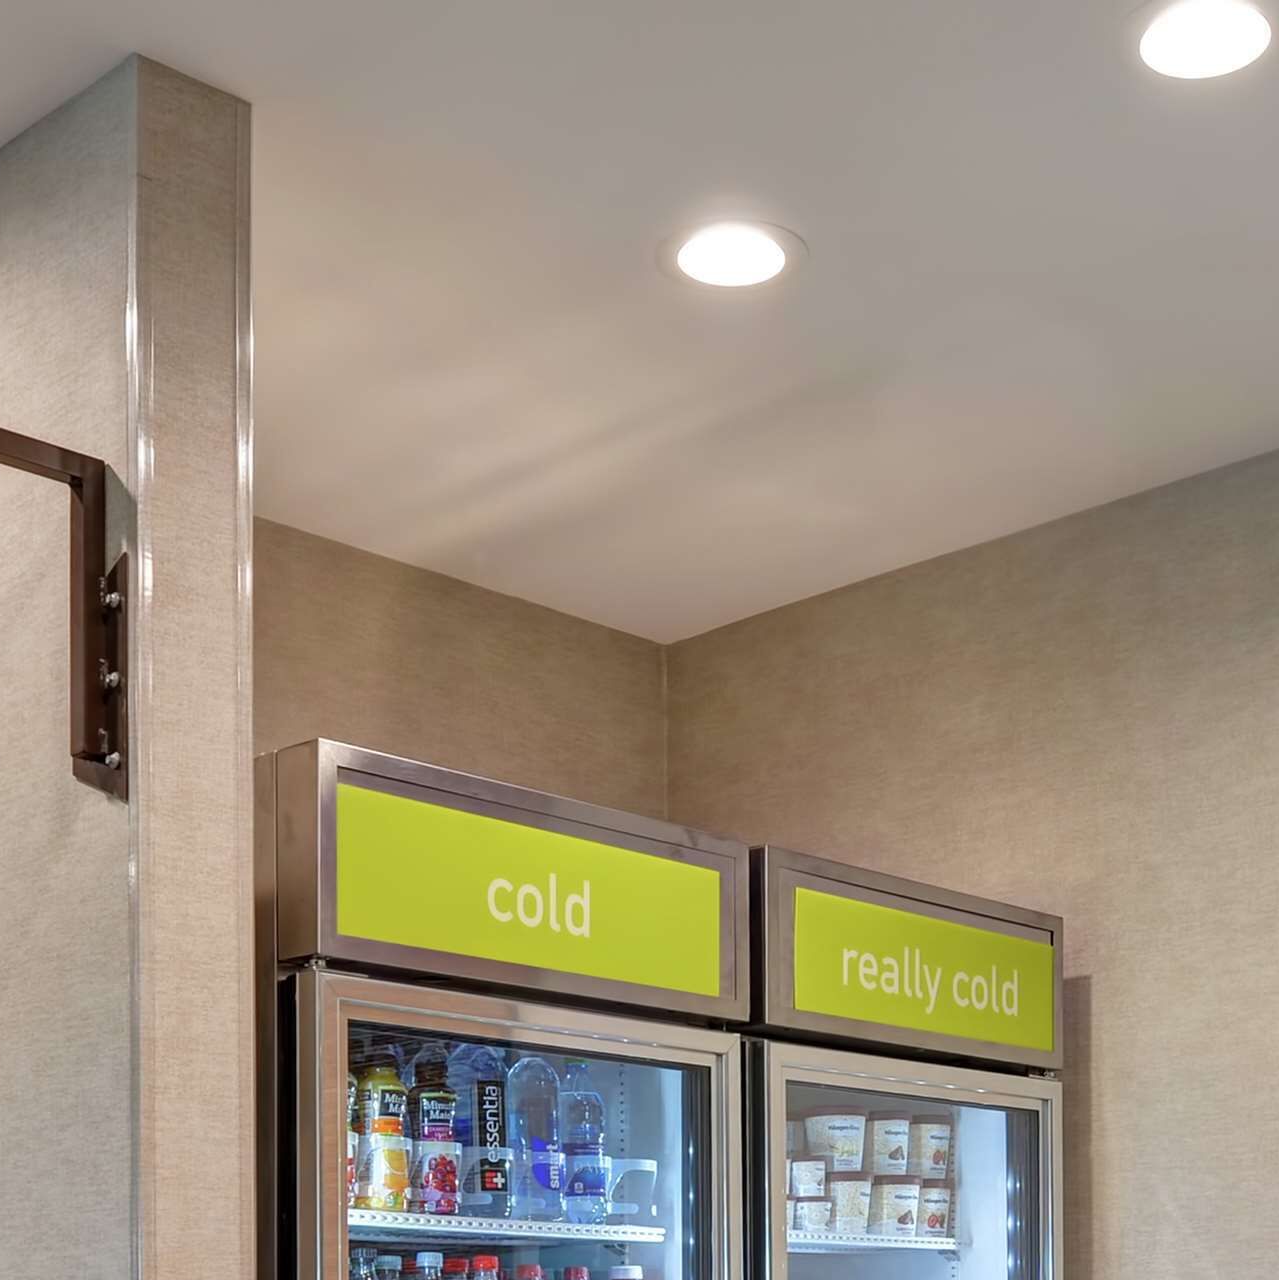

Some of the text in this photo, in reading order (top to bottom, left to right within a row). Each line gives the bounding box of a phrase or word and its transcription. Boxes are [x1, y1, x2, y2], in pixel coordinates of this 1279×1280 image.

[488, 873, 591, 939] cold
[842, 946, 1019, 1017] really cold
[483, 1085, 499, 1163] essentia
[546, 1144, 560, 1189] smart
